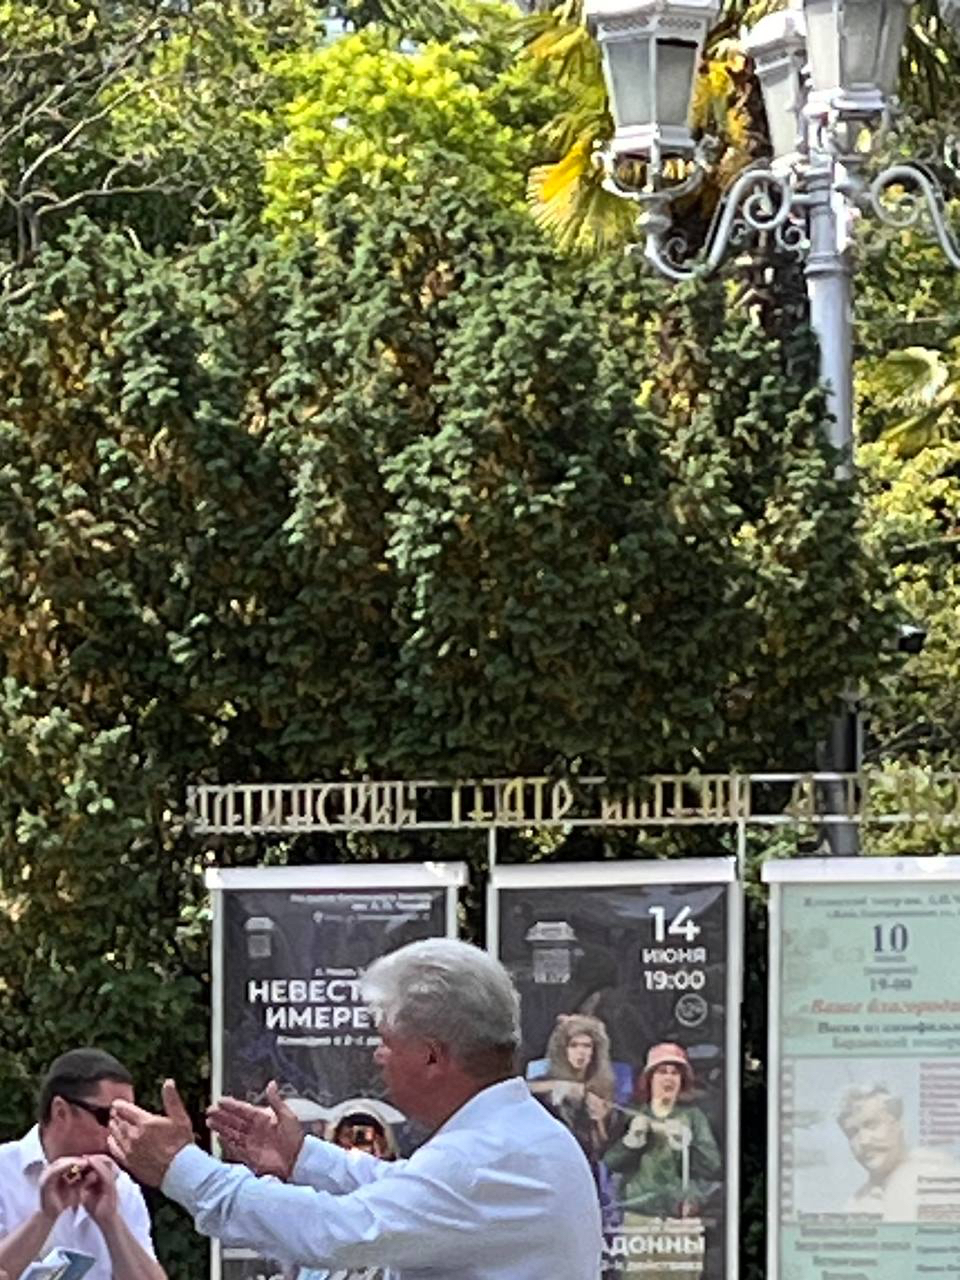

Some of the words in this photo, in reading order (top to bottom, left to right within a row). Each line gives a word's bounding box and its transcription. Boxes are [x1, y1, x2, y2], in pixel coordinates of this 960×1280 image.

[649, 906, 701, 942] 14
[873, 924, 908, 953] 10
[642, 947, 706, 963] ИЮНЯ
[644, 970, 706, 990] 19:00
